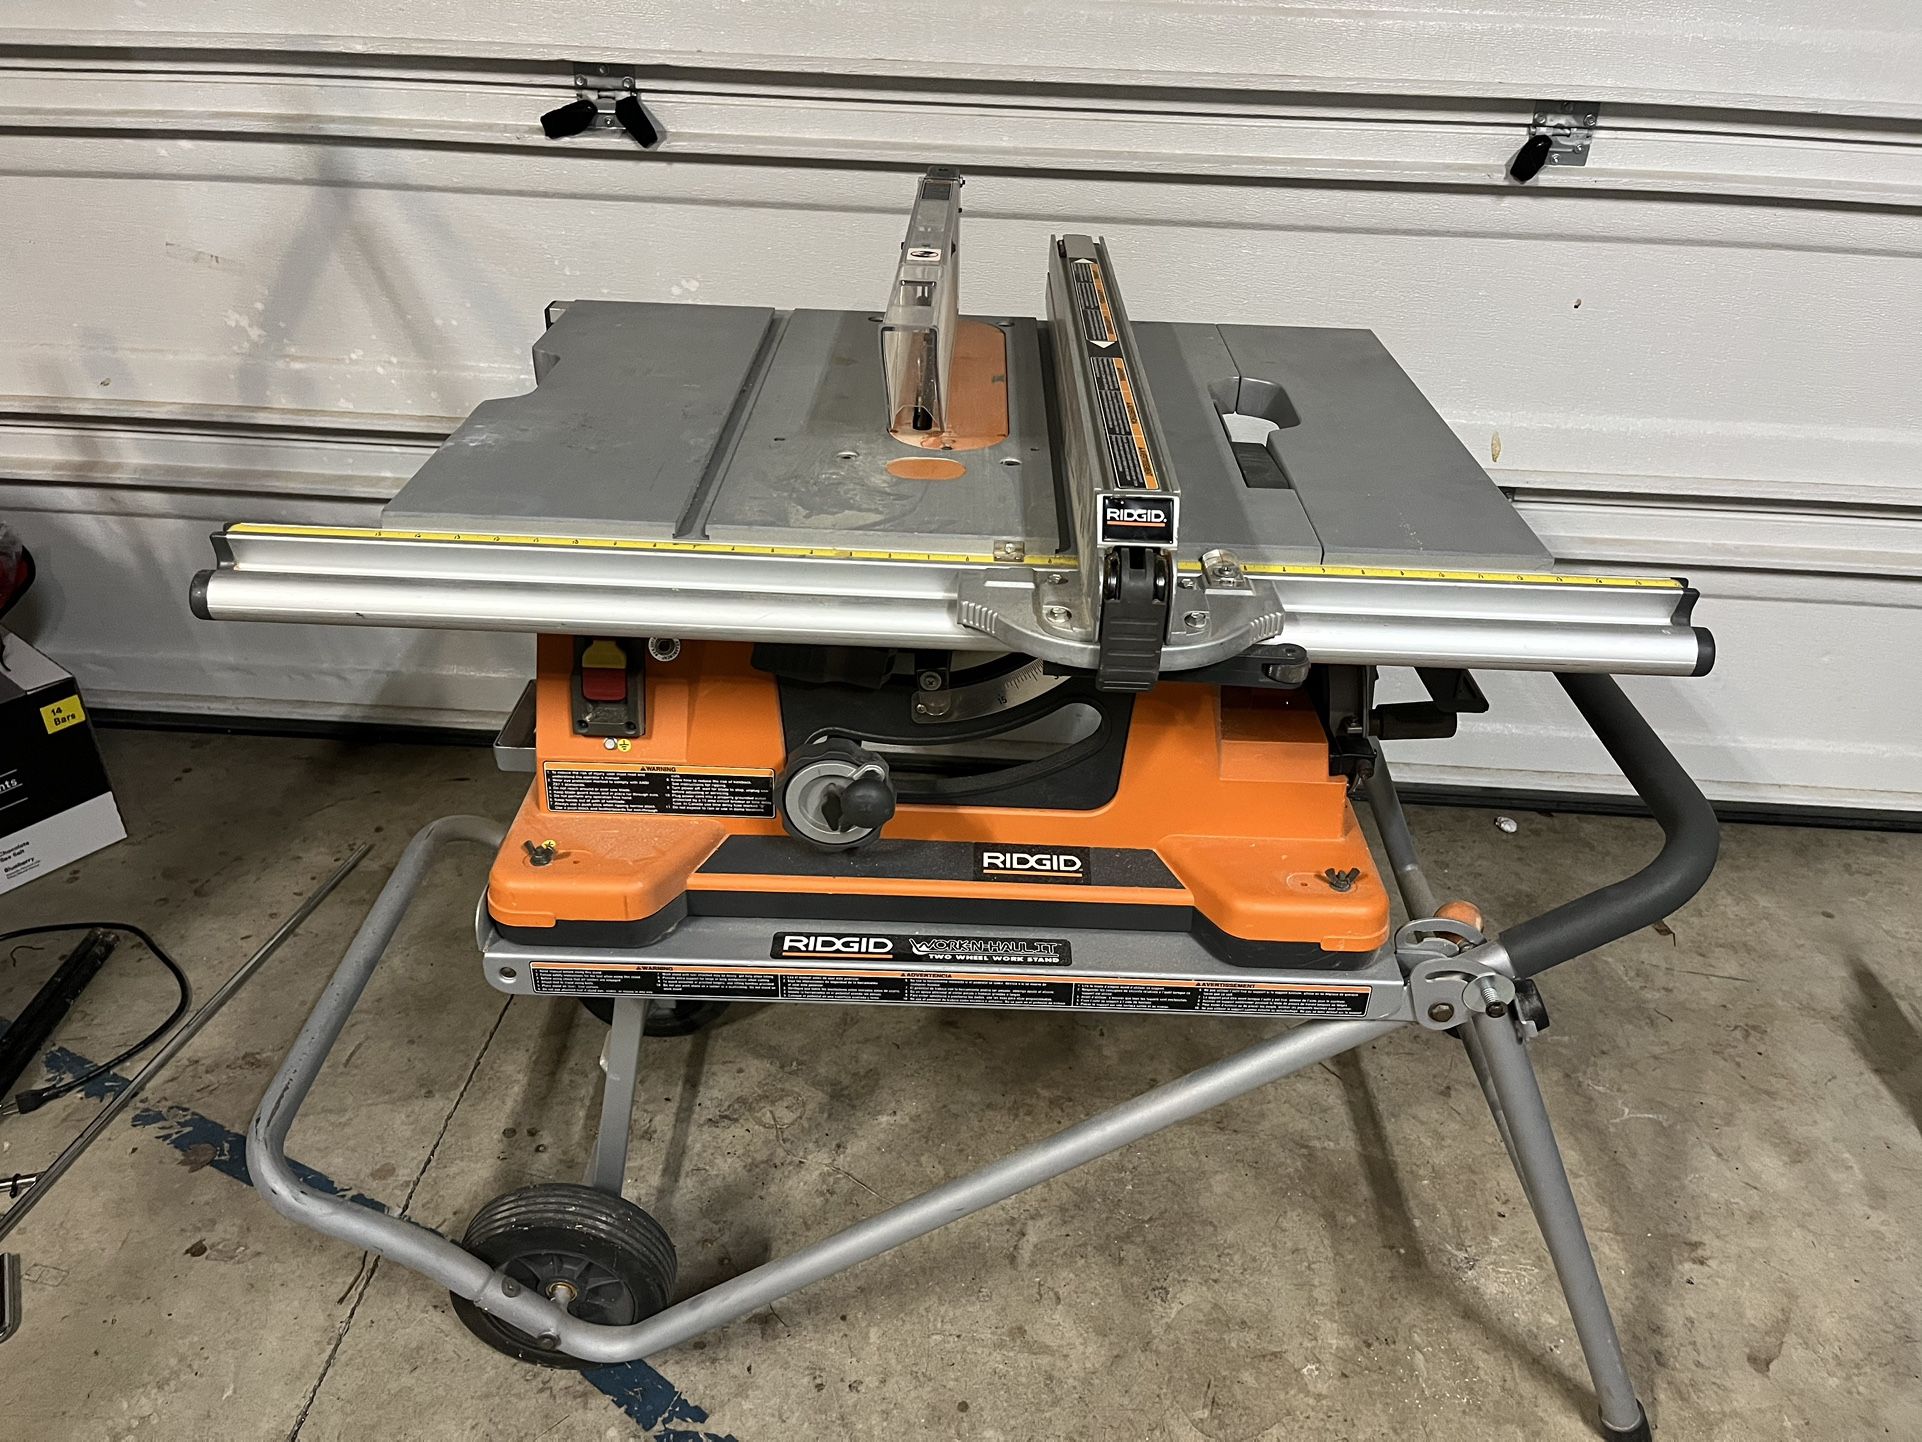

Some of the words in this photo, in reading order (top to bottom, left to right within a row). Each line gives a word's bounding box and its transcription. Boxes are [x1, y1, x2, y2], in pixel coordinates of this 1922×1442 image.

[51, 706, 63, 716] 14
[53, 713, 76, 727] Bars
[983, 852, 1082, 871] RIDGID
[782, 935, 894, 953] RIDGID
